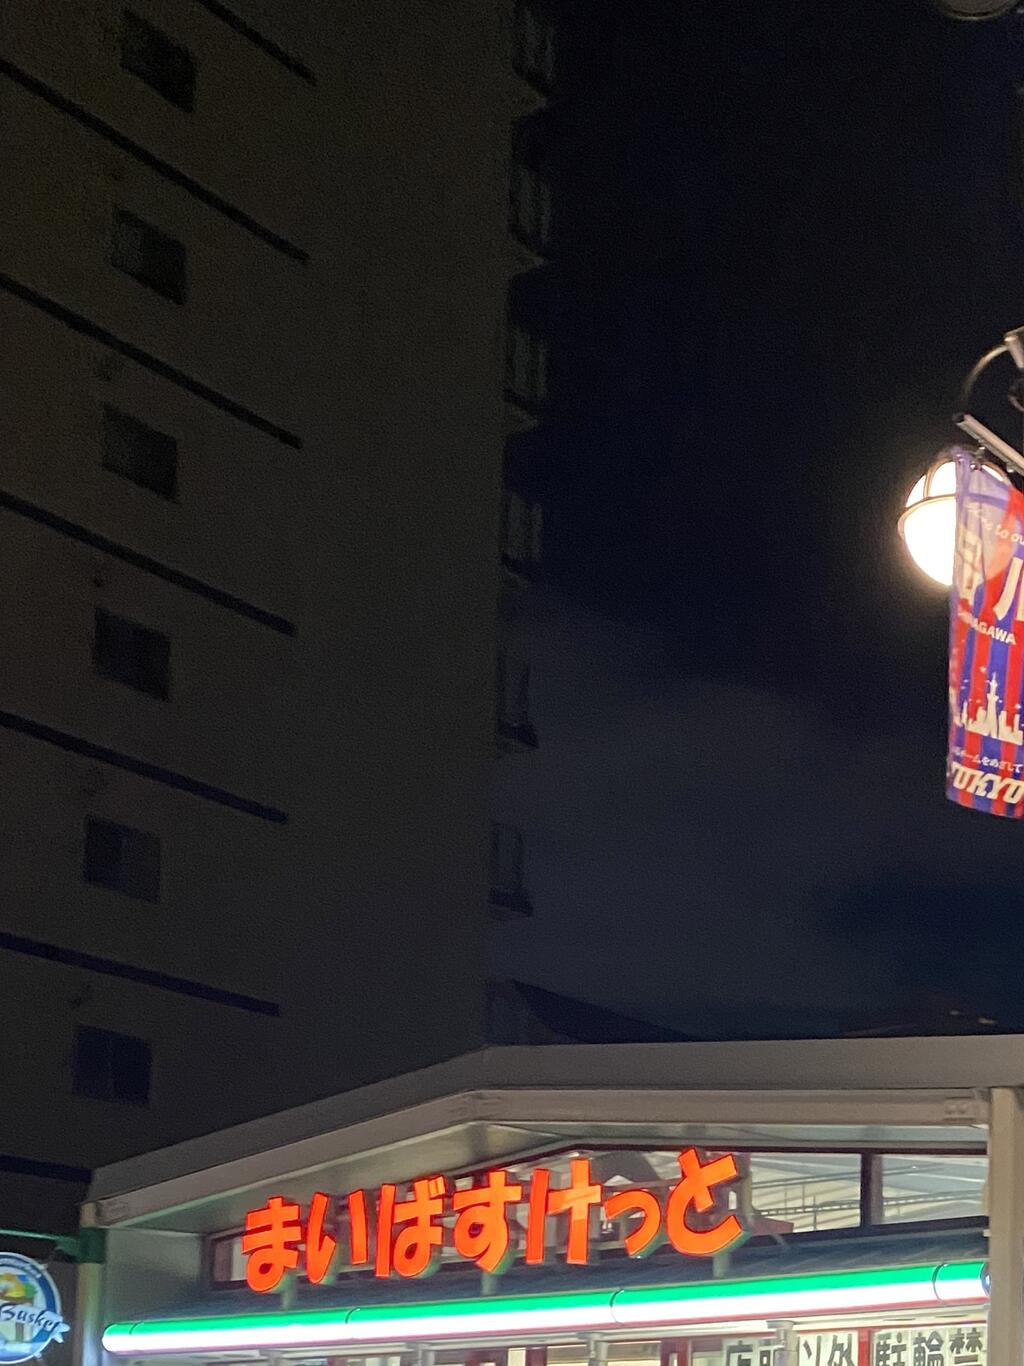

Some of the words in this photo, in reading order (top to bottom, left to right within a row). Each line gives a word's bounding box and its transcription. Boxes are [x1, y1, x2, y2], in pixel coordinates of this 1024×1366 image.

[241, 1146, 740, 1293] まいばすけっと
